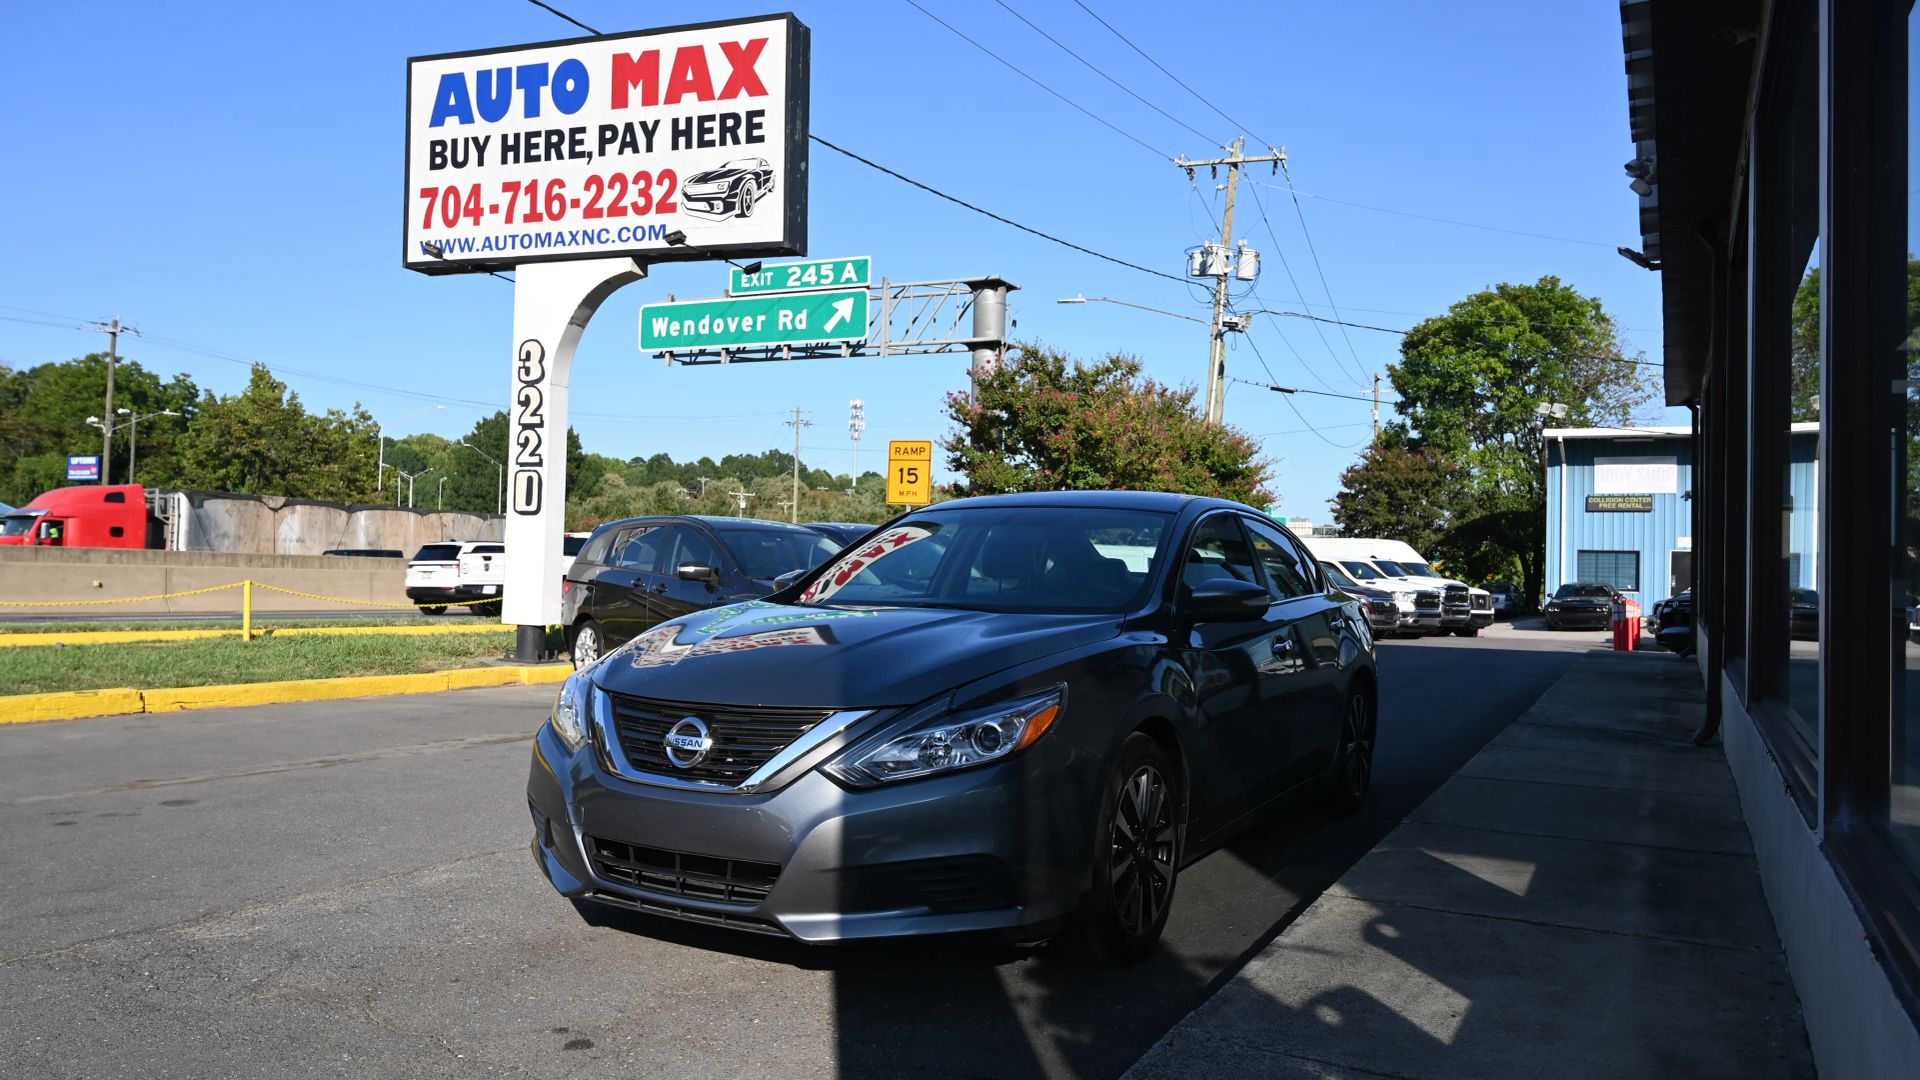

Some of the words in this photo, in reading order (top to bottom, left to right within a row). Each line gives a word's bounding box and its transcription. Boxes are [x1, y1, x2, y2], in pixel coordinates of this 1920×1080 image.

[428, 58, 590, 128] AUTO
[611, 38, 769, 110] MAX
[429, 135, 491, 171] BUY
[598, 119, 661, 157] PAY
[671, 109, 765, 151] HERE
[420, 168, 678, 229] 704-716-2232
[740, 271, 774, 288] EXIT
[787, 264, 834, 287] 245
[840, 263, 858, 283] A
[652, 314, 766, 337] Wendover
[778, 308, 808, 331] Rd
[513, 339, 546, 516] 3220
[894, 446, 926, 456] RAMP
[898, 467, 919, 485] 15
[667, 736, 704, 748] NISSAN
